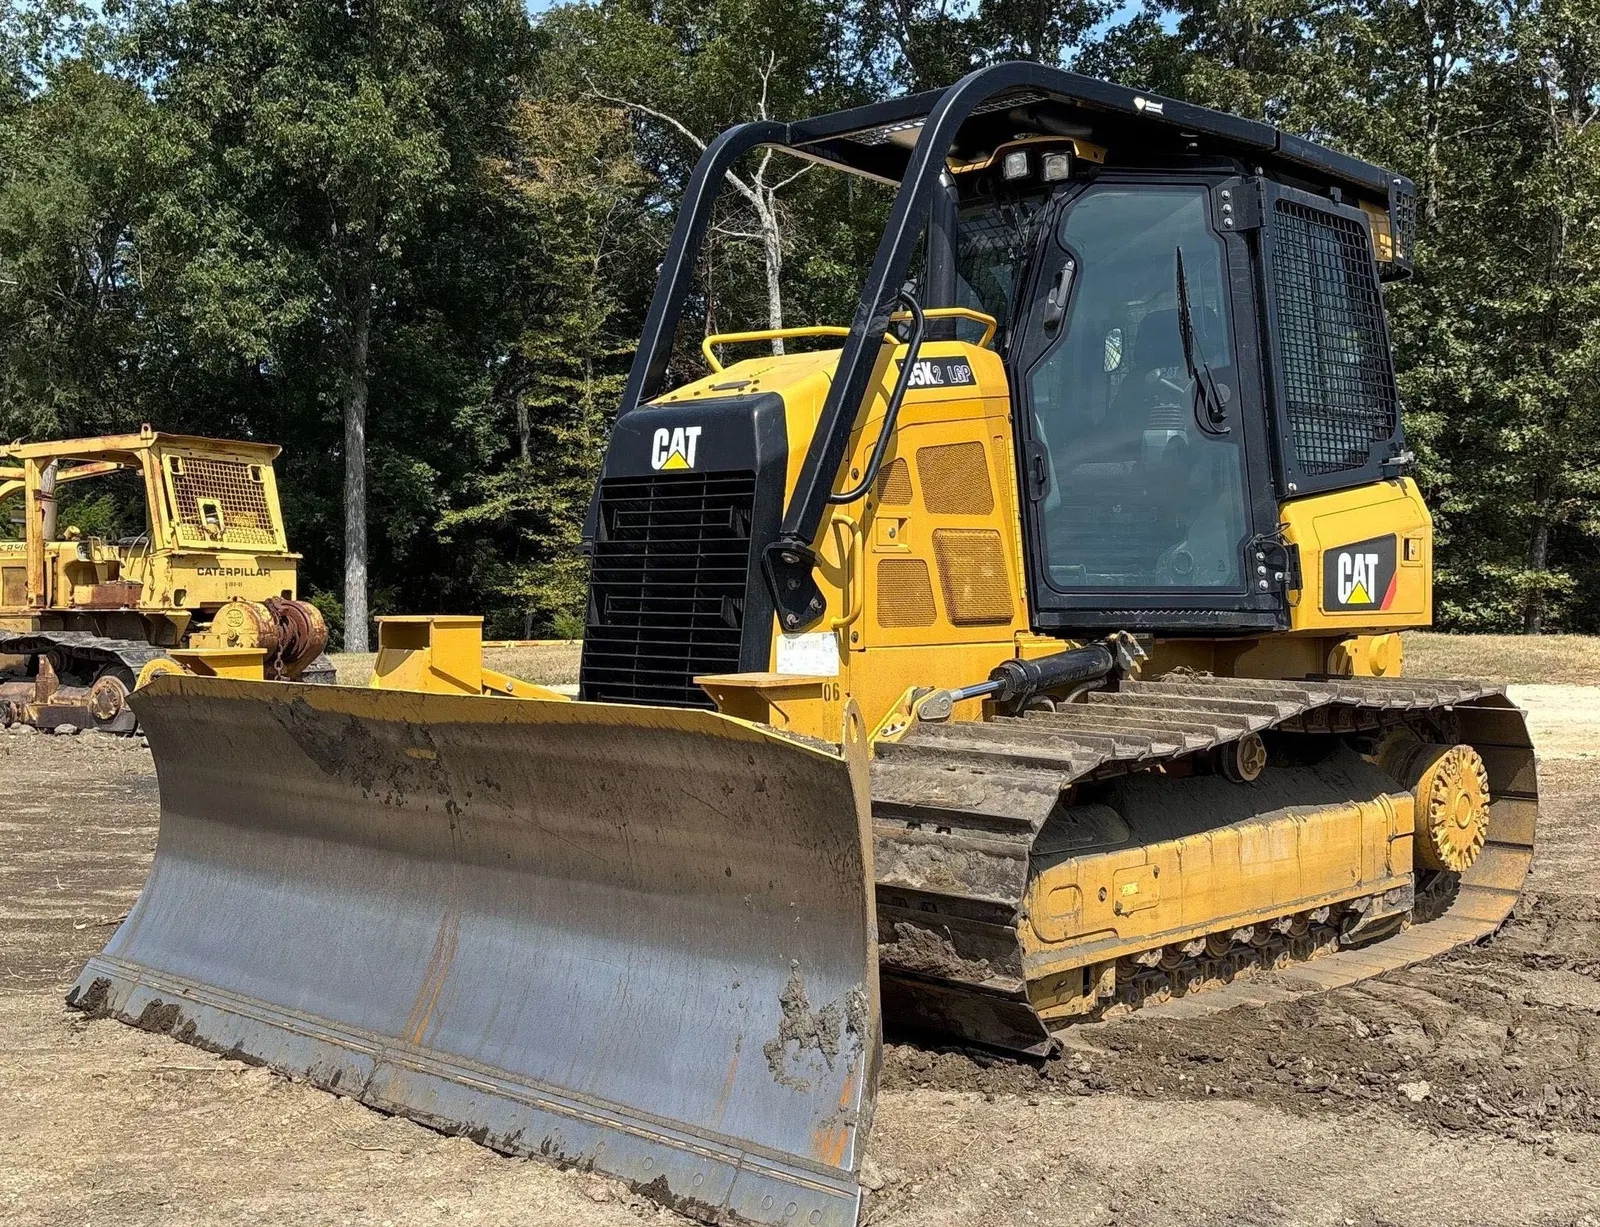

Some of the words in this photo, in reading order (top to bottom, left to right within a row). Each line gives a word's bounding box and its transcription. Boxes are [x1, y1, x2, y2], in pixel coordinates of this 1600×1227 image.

[947, 365, 970, 383] LGP
[651, 426, 702, 470] CAT
[197, 567, 271, 577] CATERPILLAR
[1337, 552, 1378, 604] CAT
[823, 682, 840, 702] 06
